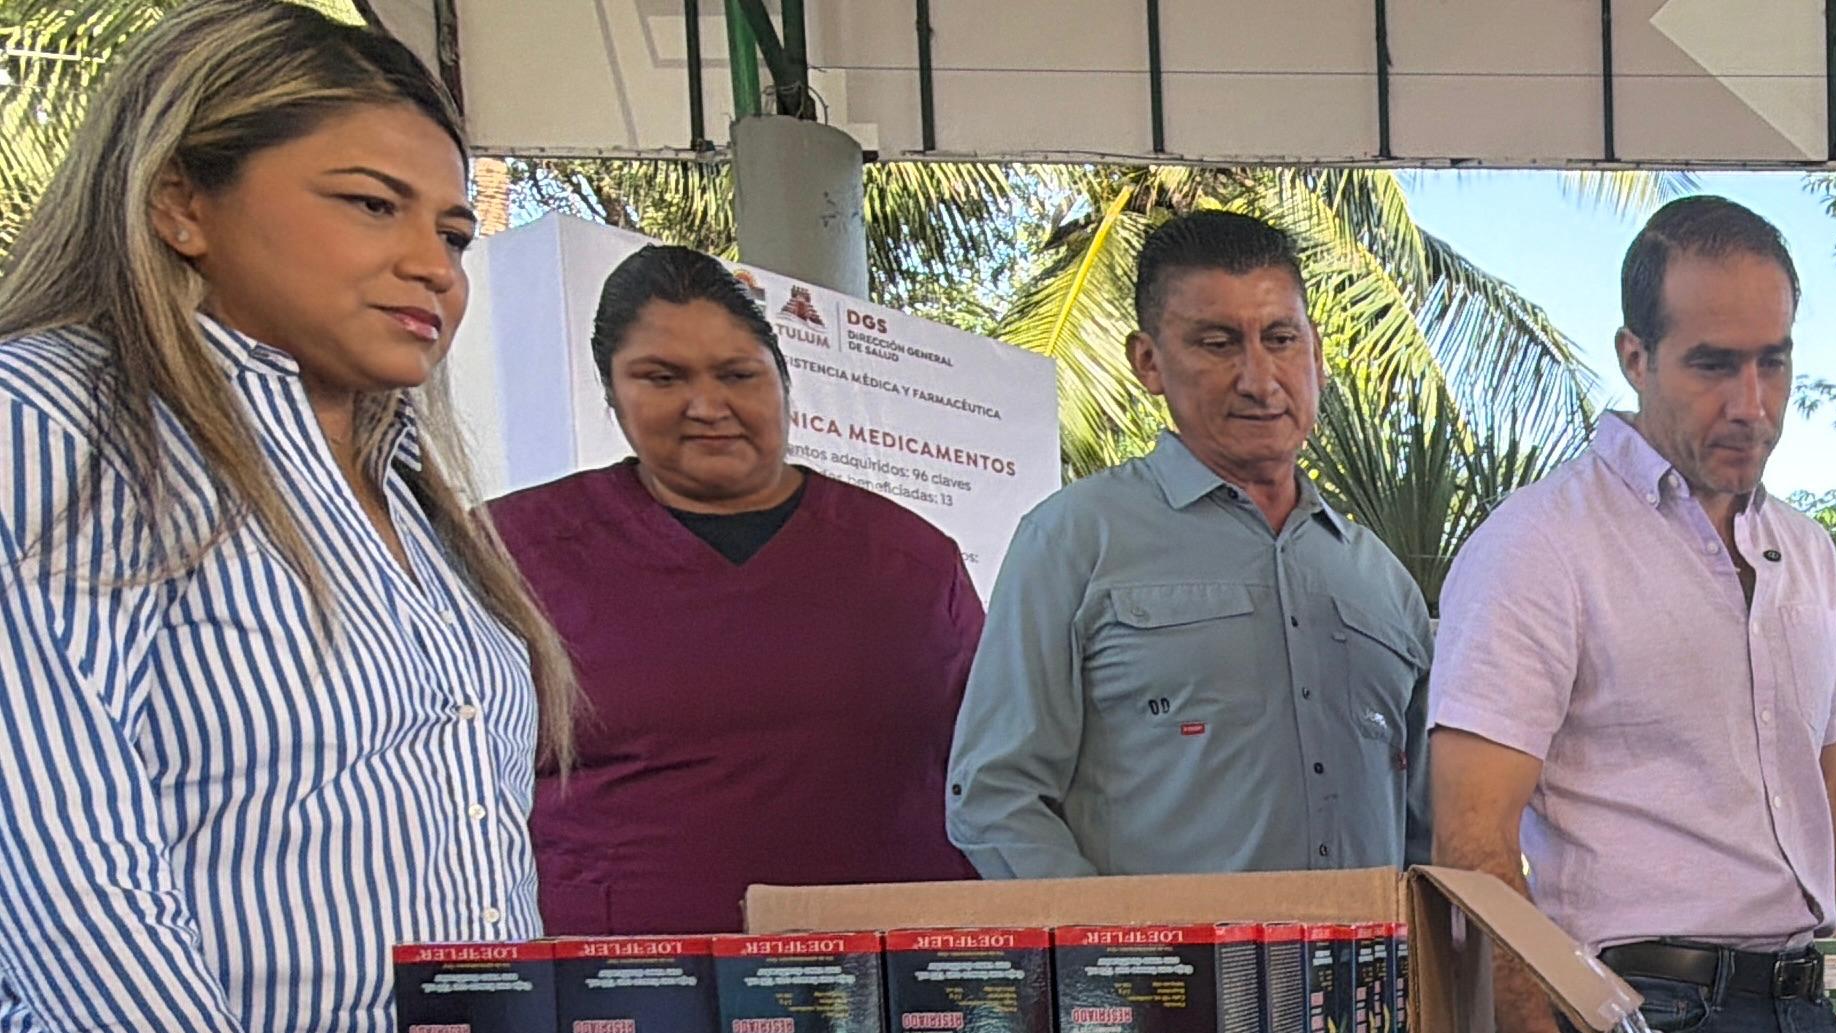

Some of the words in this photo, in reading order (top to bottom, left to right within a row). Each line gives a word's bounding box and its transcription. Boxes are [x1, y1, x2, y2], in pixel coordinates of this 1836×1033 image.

[776, 324, 830, 349] TULUM
[847, 309, 888, 335] DGS
[847, 330, 905, 353] DIRECCIÓN
[906, 346, 954, 367] GENERAL
[848, 340, 863, 354] DE
[864, 344, 900, 363] SALUD
[785, 354, 848, 381] ISTENCIA
[851, 370, 899, 396] MÉDICA
[902, 385, 910, 397] Y
[912, 388, 1001, 420] FARMACÉUTICA
[849, 424, 1016, 476] MEDICAMENTOS
[831, 452, 911, 478] adquiridos:
[912, 468, 929, 482] 96
[931, 473, 972, 492] claves
[940, 493, 954, 507] 13
